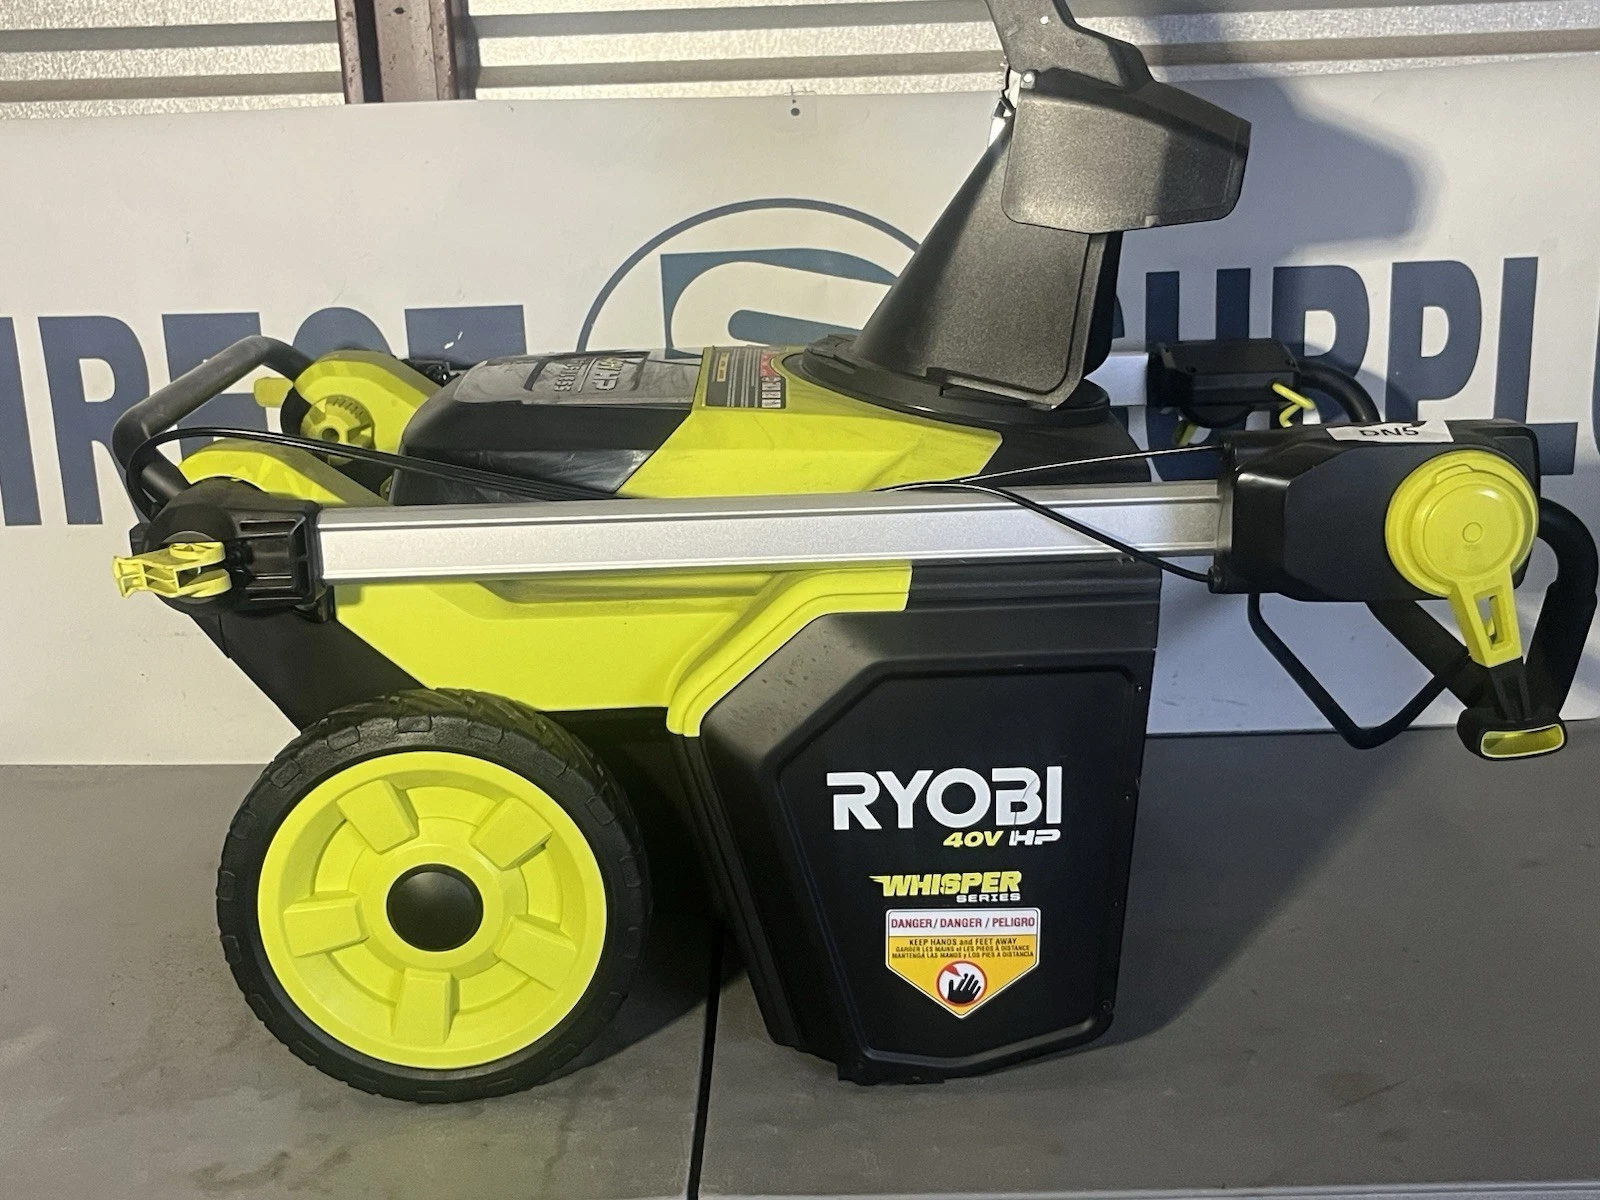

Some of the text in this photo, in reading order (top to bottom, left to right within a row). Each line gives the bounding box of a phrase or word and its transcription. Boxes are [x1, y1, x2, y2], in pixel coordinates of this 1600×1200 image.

[1110, 256, 1600, 483] UPPL
[1359, 427, 1419, 436] DN5
[827, 766, 1062, 830] RYOBI
[943, 829, 1061, 848] 40V HP
[868, 870, 1022, 897] WHISPER
[956, 892, 1021, 903] SERIES
[940, 918, 982, 928] DANGER
[992, 917, 1035, 927] PELIGRO
[909, 938, 928, 946] KEEP
[930, 938, 957, 946] HANDS
[995, 937, 1017, 945] AWAY
